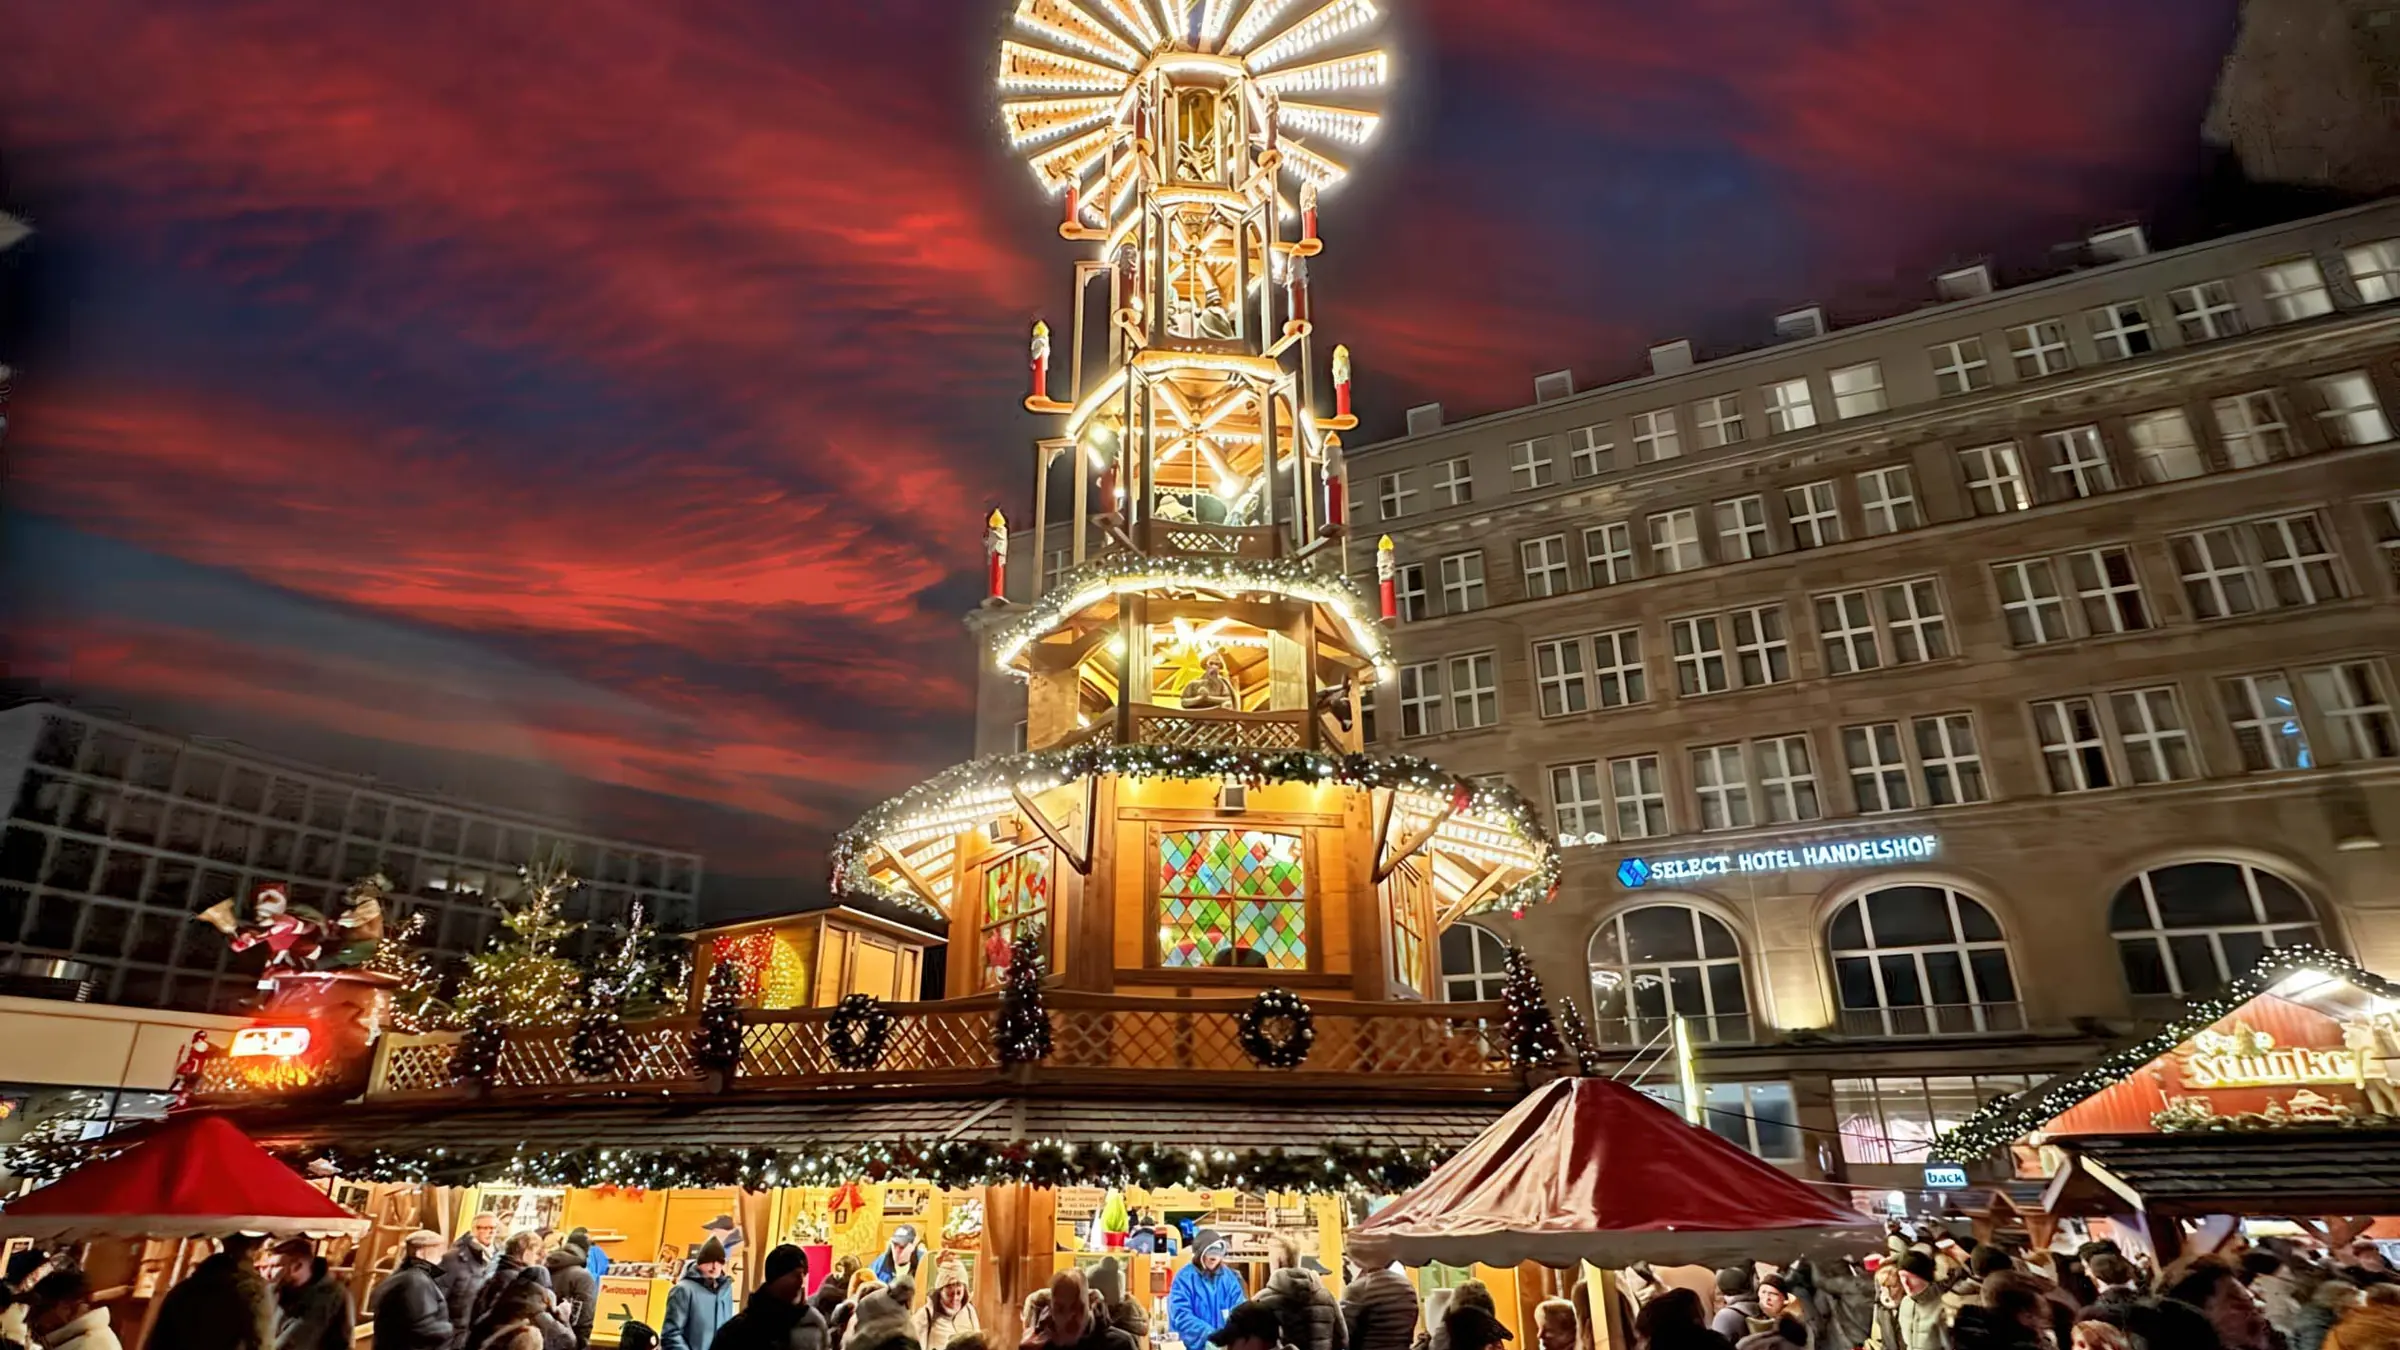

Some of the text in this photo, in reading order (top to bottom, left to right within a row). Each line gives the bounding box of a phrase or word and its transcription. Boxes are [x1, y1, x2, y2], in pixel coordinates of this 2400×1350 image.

[1651, 835, 1937, 880] SELECT HOTEL HANDELSHOF
[1927, 1171, 1964, 1184] back
